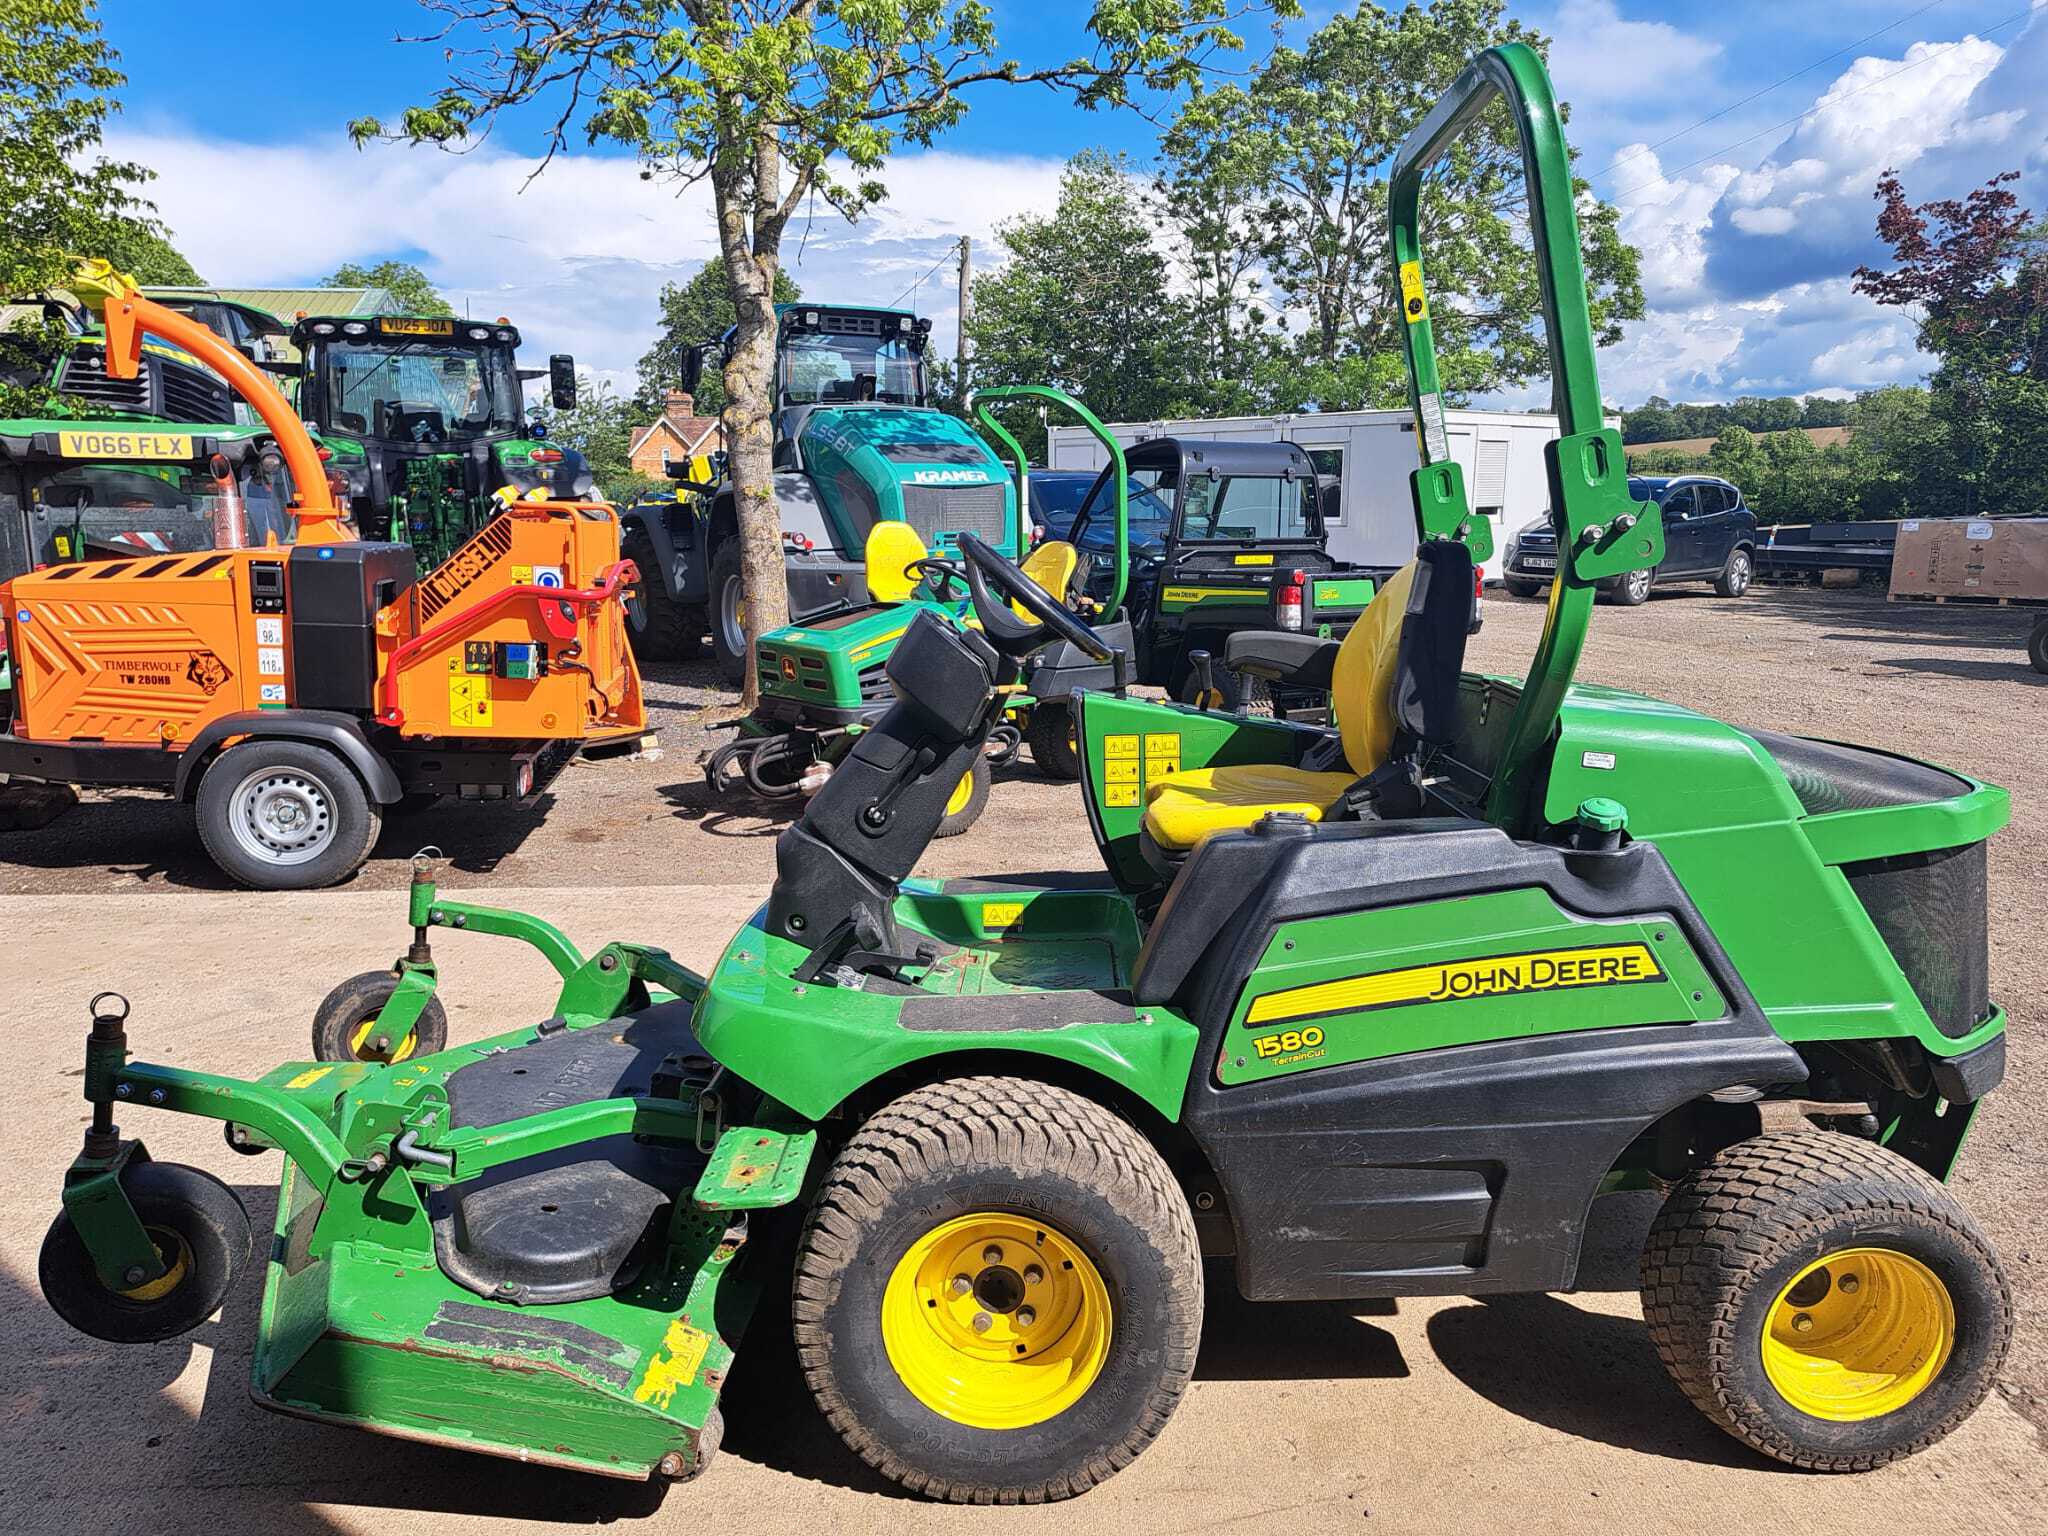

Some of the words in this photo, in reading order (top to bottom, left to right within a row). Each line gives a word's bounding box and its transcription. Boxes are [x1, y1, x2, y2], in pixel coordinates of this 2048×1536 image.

[138, 436, 182, 456] FLX
[913, 471, 992, 482] KRAMER
[434, 541, 499, 598] DIESEL
[262, 629, 274, 643] 98
[103, 660, 184, 672] TIMBERWOLF
[120, 674, 135, 684] TW
[1430, 966, 1520, 996] JOHN
[1530, 956, 1641, 985] DEERE
[1252, 1026, 1325, 1059] 1580
[1272, 1048, 1326, 1066] TerrainCut
